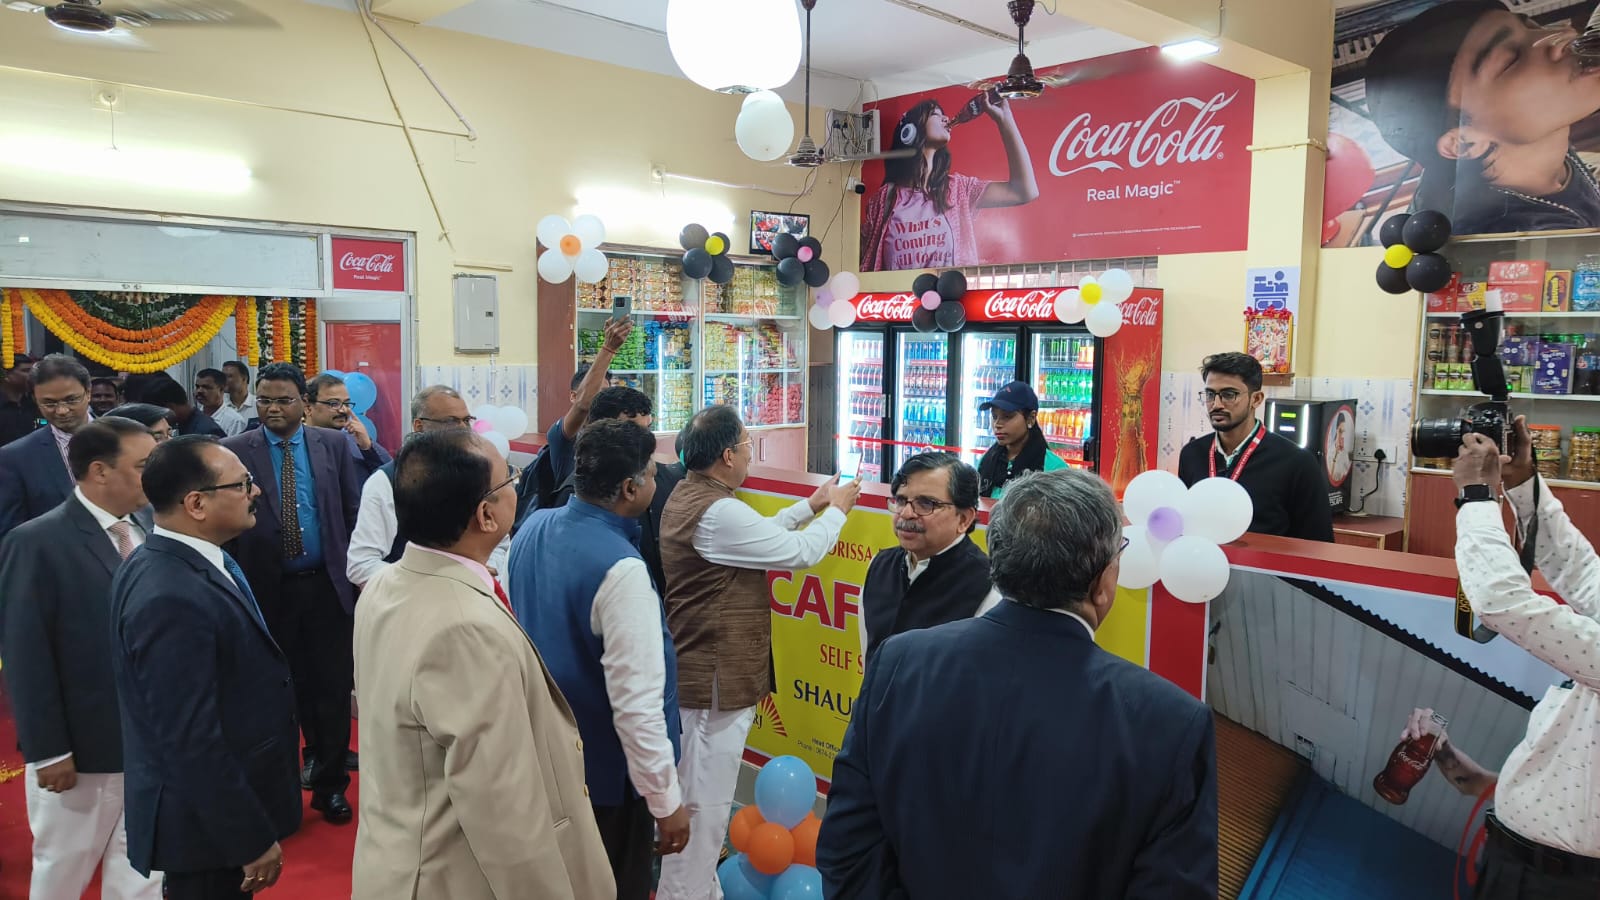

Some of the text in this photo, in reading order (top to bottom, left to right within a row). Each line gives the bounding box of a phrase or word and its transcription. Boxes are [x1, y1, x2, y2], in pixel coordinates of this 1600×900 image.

[1049, 89, 1239, 176] Coca-Cola
[1087, 187, 1120, 201] Real
[895, 232, 947, 252] Coming
[340, 252, 395, 273] Coca-Cola
[857, 294, 915, 319] Coca-Cola
[985, 290, 1059, 318] Coca-Cola
[820, 644, 852, 670] SELF
[794, 680, 851, 716] SHAU
